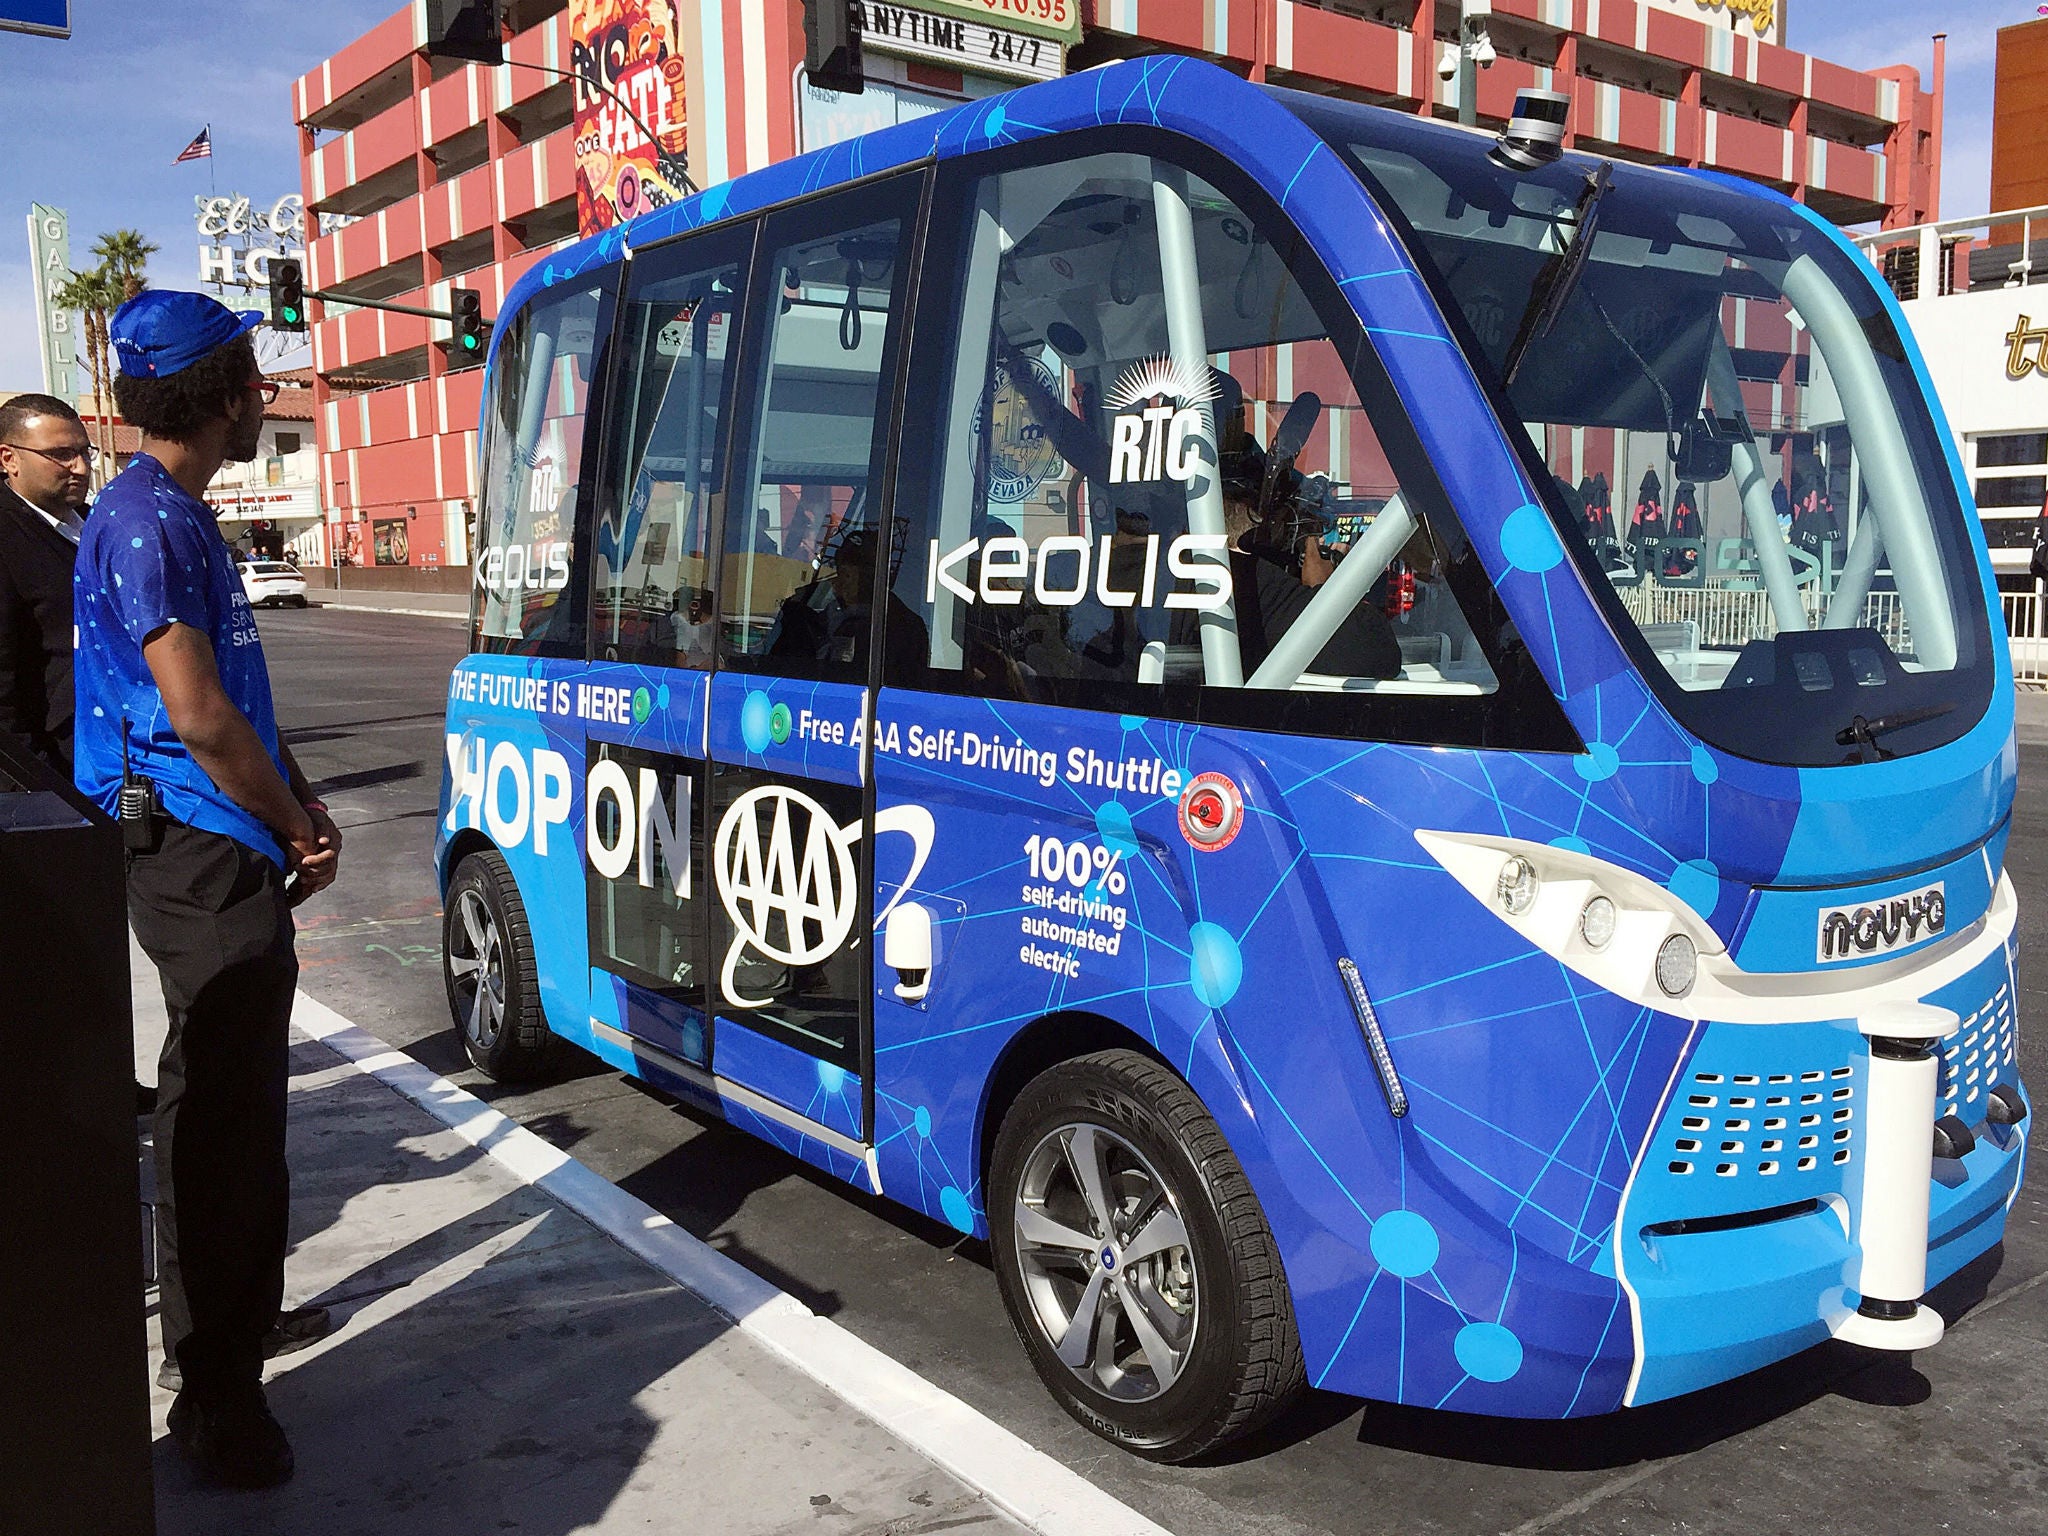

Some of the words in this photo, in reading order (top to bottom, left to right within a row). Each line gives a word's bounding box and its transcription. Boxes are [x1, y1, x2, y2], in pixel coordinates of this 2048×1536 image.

[859, 1, 965, 51] ANYTIME
[989, 31, 1040, 67] 24/7
[198, 197, 249, 235] El
[43, 216, 76, 408] GAMBLI
[1109, 406, 1202, 483] RTC
[530, 464, 561, 512] RTC
[451, 669, 475, 701] THE
[479, 672, 548, 713] FUTURE
[552, 681, 570, 715] IS
[577, 683, 631, 725] HERE
[799, 710, 844, 747] Free
[849, 716, 901, 755] AAA
[908, 723, 1057, 788] Self-Driving
[1066, 747, 1183, 799] Shuttle
[446, 733, 572, 857] HOP
[587, 759, 692, 900] ON
[1023, 834, 1127, 896] 100%
[1021, 885, 1127, 931] self-driving
[1021, 916, 1121, 957] automated
[1020, 943, 1080, 979] electric
